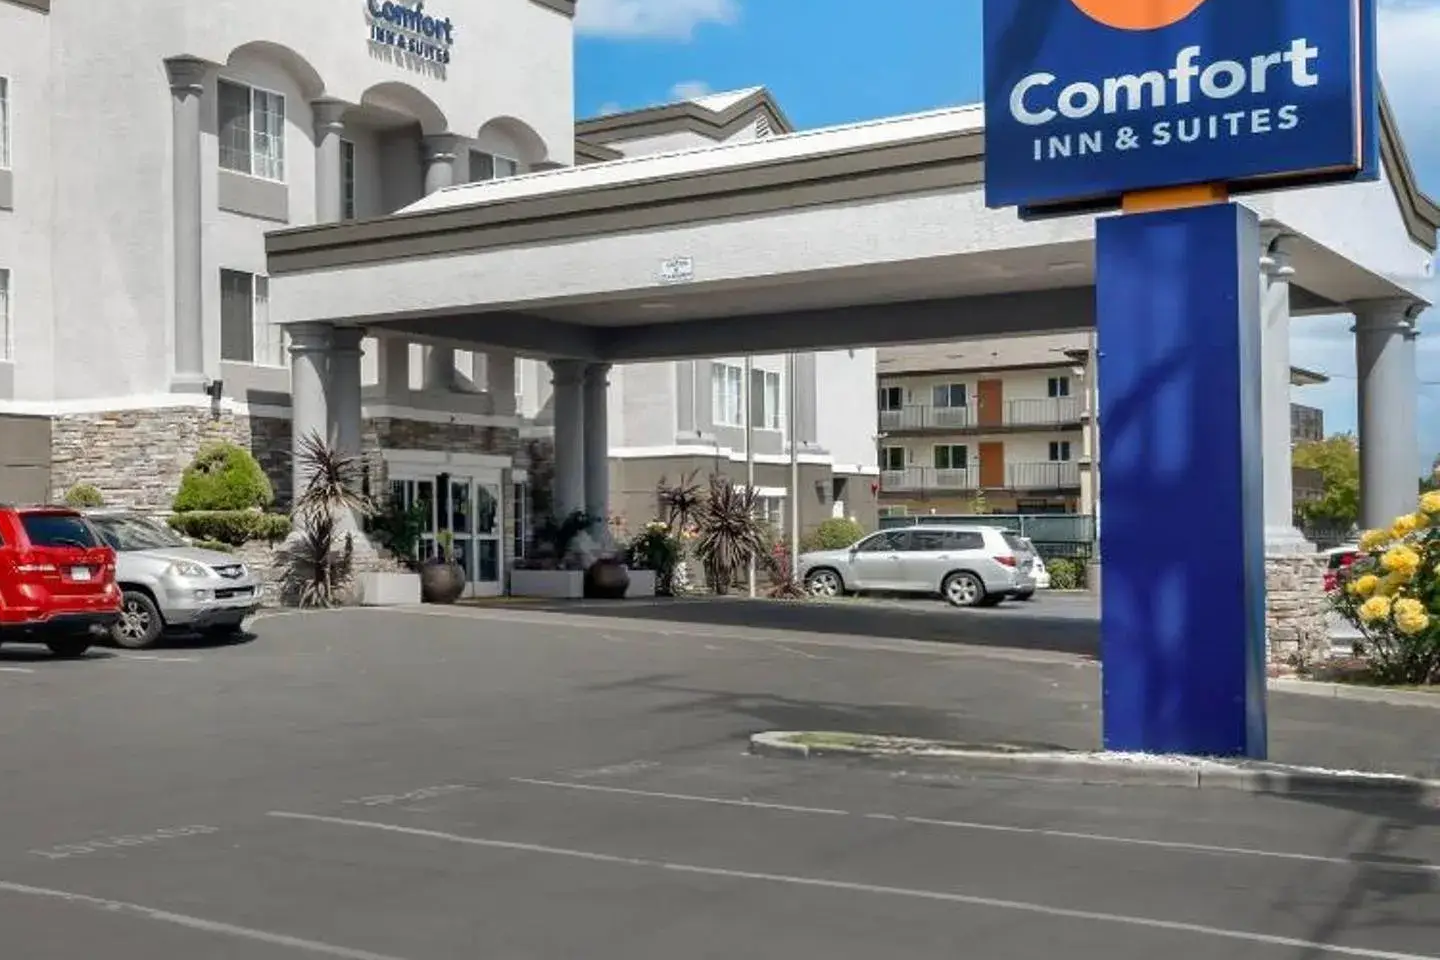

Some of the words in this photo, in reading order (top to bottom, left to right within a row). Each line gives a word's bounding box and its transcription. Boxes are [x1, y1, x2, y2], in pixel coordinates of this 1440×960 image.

[371, 25, 395, 45] INN
[408, 38, 451, 64] SUITES
[1009, 38, 1319, 126] Comfort
[1033, 130, 1103, 161] INN
[1114, 126, 1140, 150] &
[1152, 105, 1300, 147] SUITES
